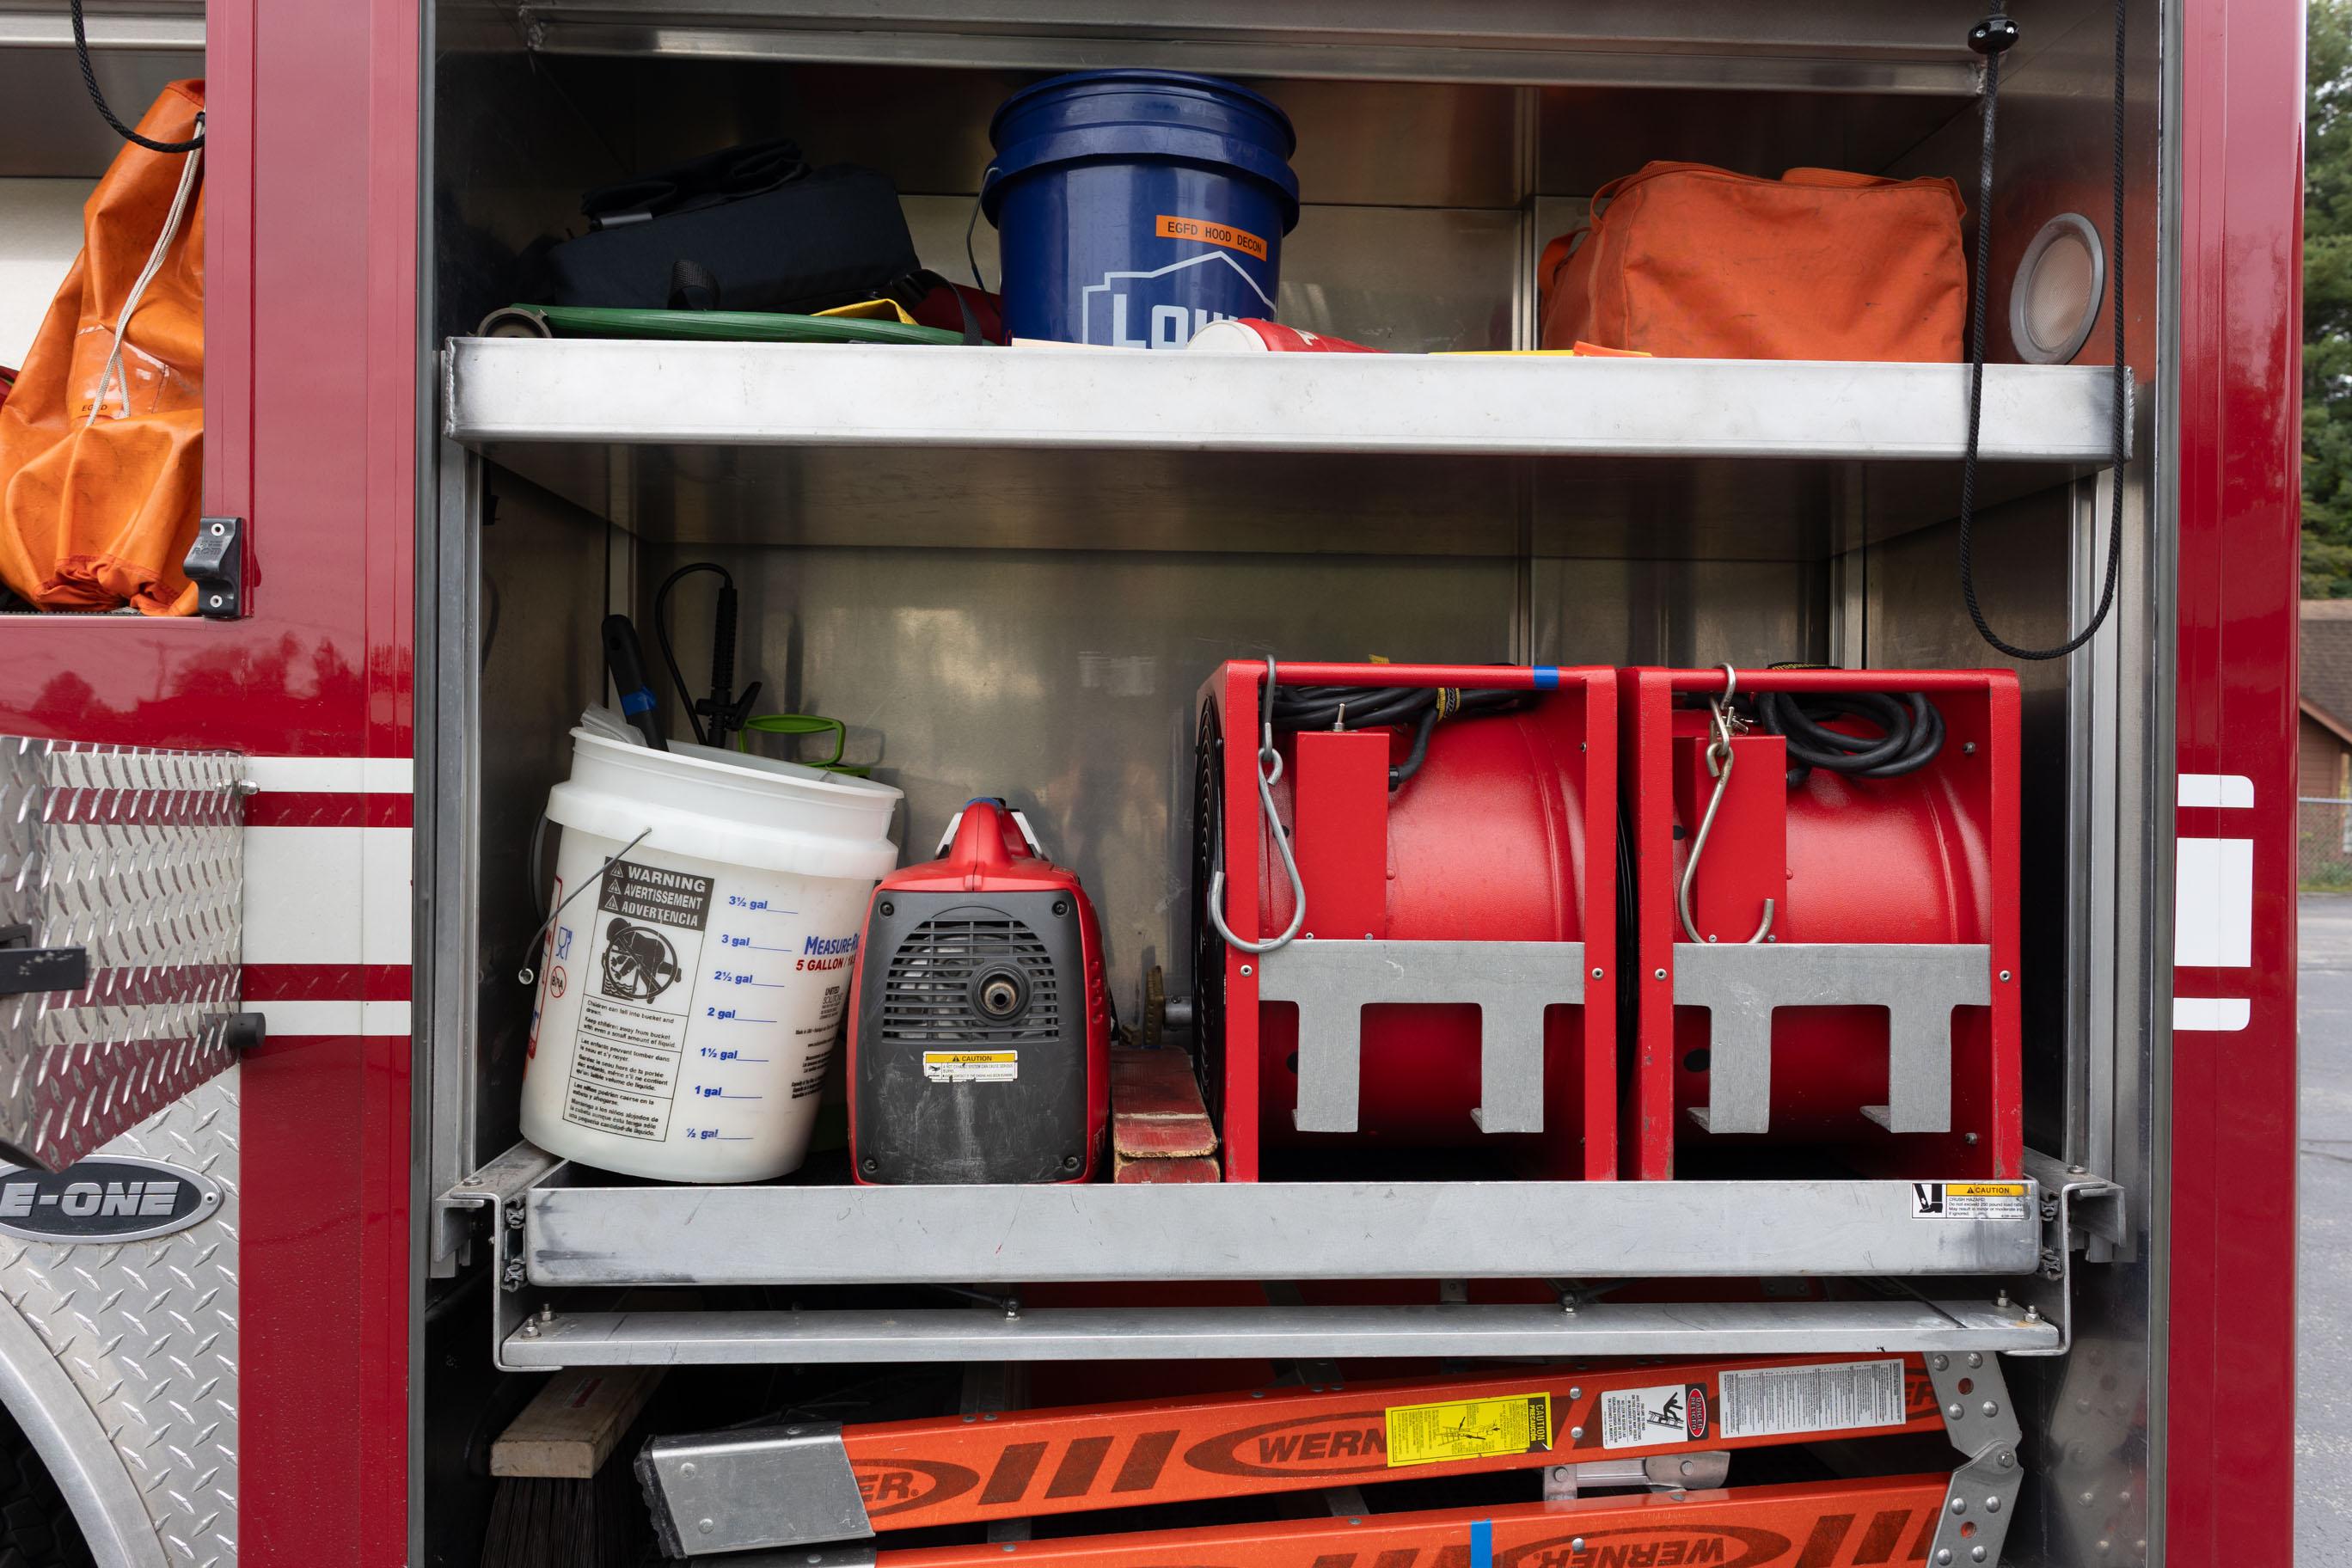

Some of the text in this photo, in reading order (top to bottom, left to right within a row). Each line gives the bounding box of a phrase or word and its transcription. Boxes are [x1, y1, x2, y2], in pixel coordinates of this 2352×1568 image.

[1167, 221, 1262, 254] EGFD HOOD DECON
[628, 866, 706, 892] WARNING
[624, 884, 703, 910] AVERTISSEMENT
[750, 901, 768, 910] gal
[622, 901, 698, 927] ADVERTENCIA
[722, 934, 750, 947] 3 gal
[796, 959, 805, 971] 5
[806, 958, 844, 971] GALLON
[735, 975, 752, 984] gal
[587, 1000, 607, 1010] Children
[641, 1013, 661, 1022] bucket
[707, 1008, 736, 1020] 2 gal
[619, 1026, 634, 1034] away
[650, 1031, 670, 1040] bucket
[628, 1034, 649, 1043] amount
[633, 1050, 653, 1059] tomber
[720, 1050, 738, 1060] gal
[704, 1087, 721, 1097] gal
[701, 1130, 718, 1139] gal
[0, 1182, 180, 1216] E-ONE
[1536, 1405, 1545, 1440] CAUTION
[1259, 1428, 1387, 1464] WERN
